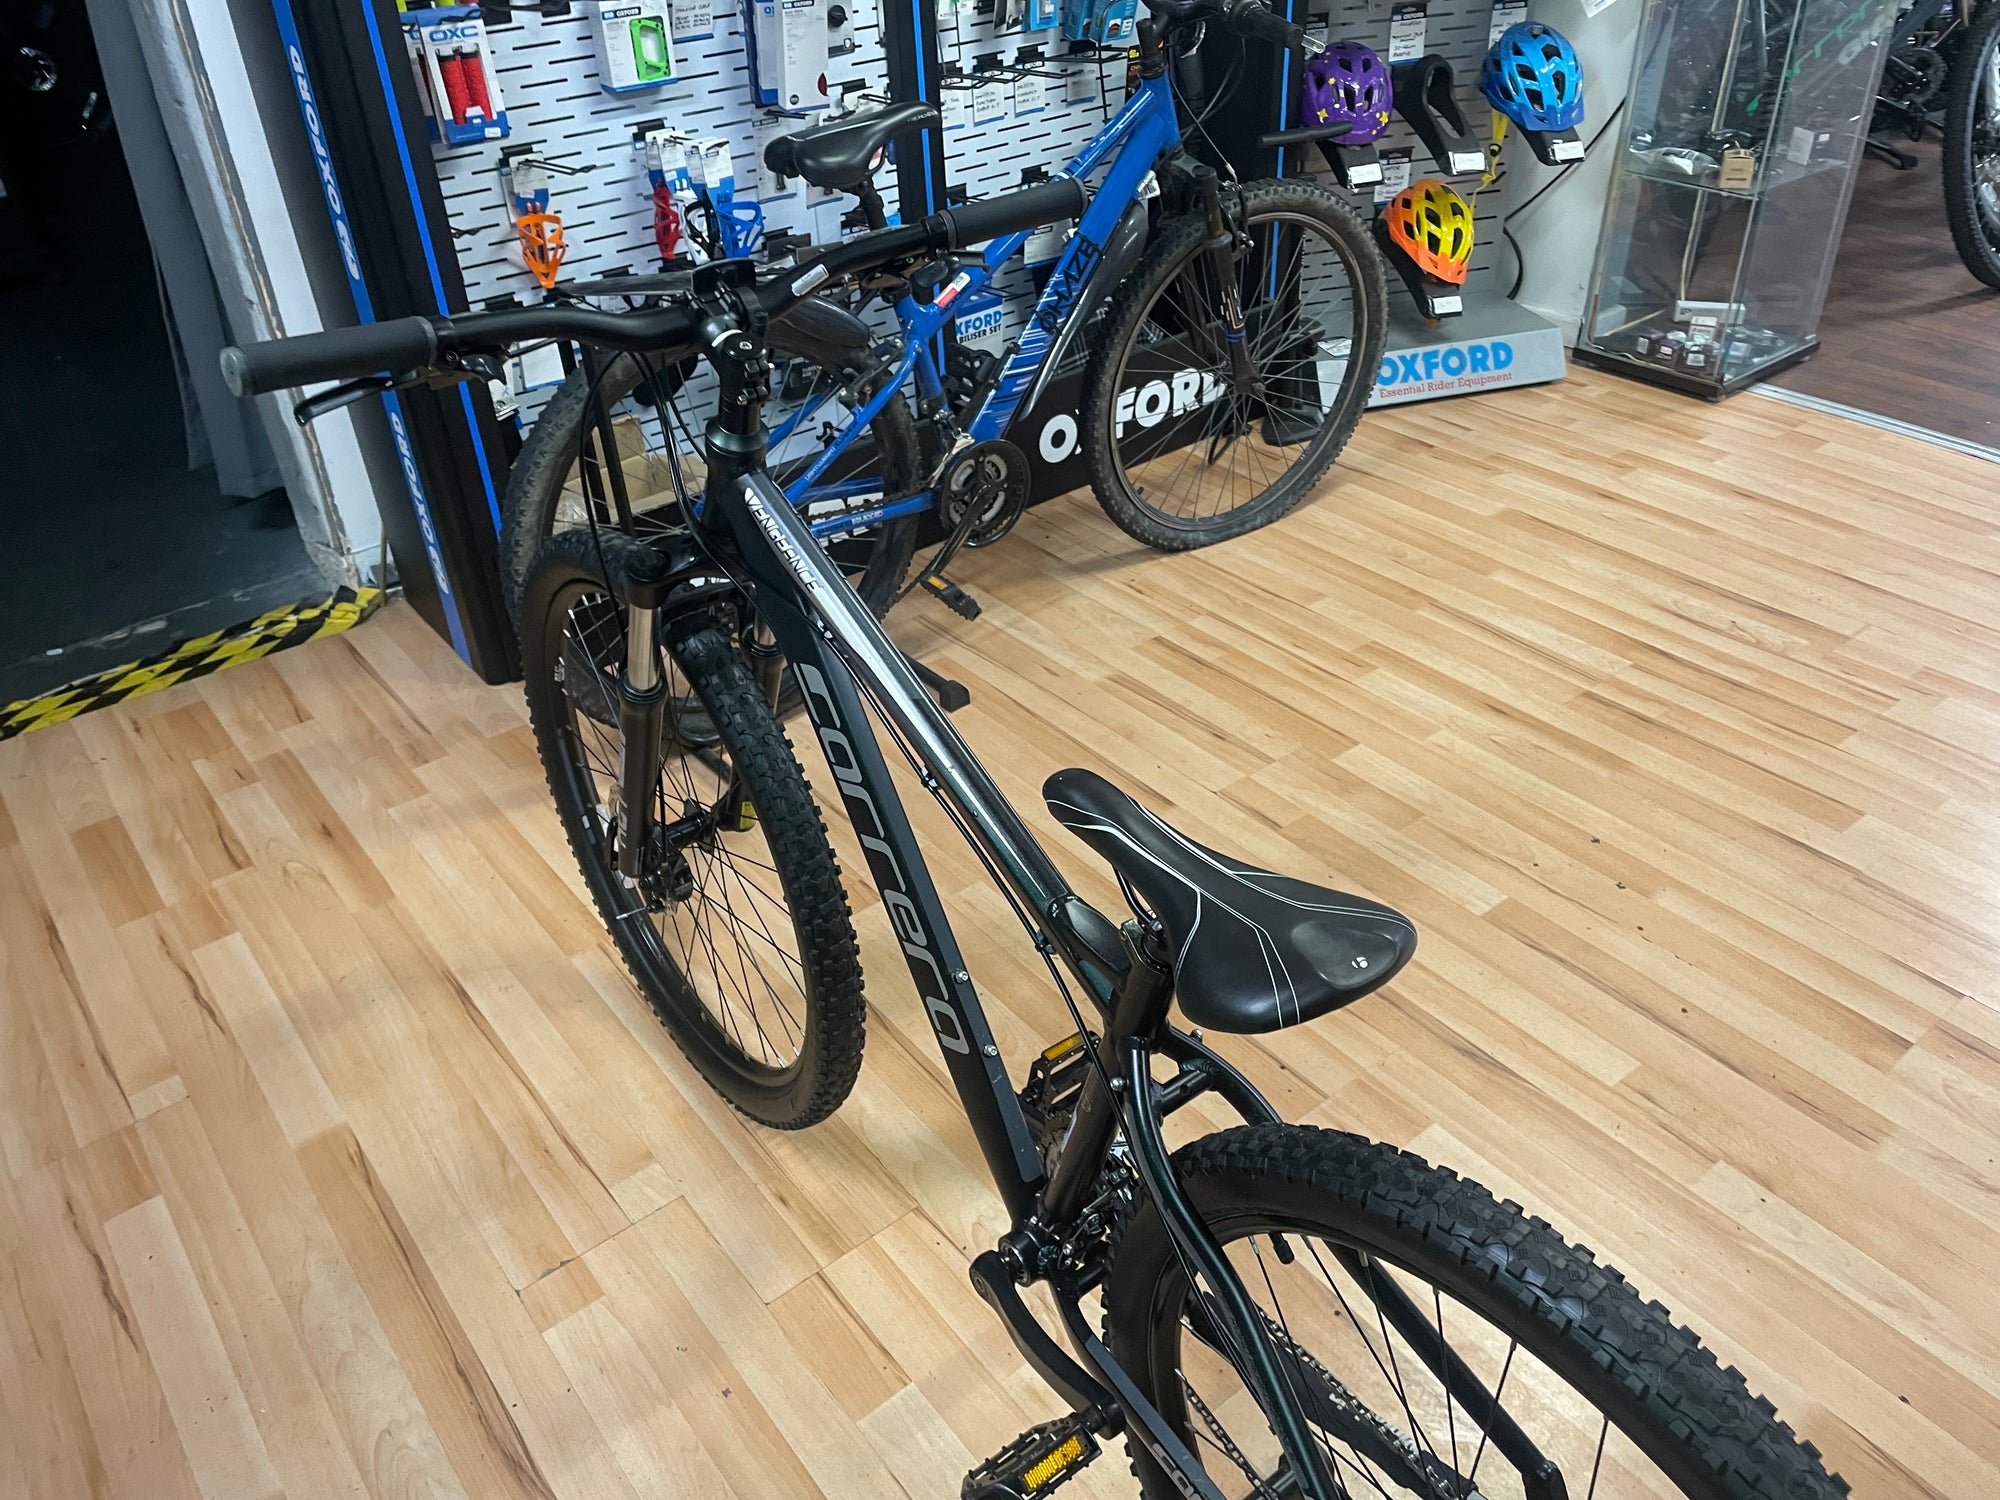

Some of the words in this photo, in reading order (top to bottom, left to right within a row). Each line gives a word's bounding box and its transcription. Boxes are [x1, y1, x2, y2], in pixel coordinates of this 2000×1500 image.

[429, 25, 479, 43] OXC
[616, 8, 640, 17] OXFORD
[288, 44, 340, 215] OXFORD
[989, 323, 1002, 335] SET
[1377, 342, 1514, 386] OXFORD
[1379, 383, 1426, 398] Essential
[1428, 379, 1455, 392] Rider
[1457, 372, 1513, 388] Equipment
[1039, 367, 1228, 464] OFORD
[391, 411, 435, 545] OXFORD
[793, 661, 971, 1055] carrera
